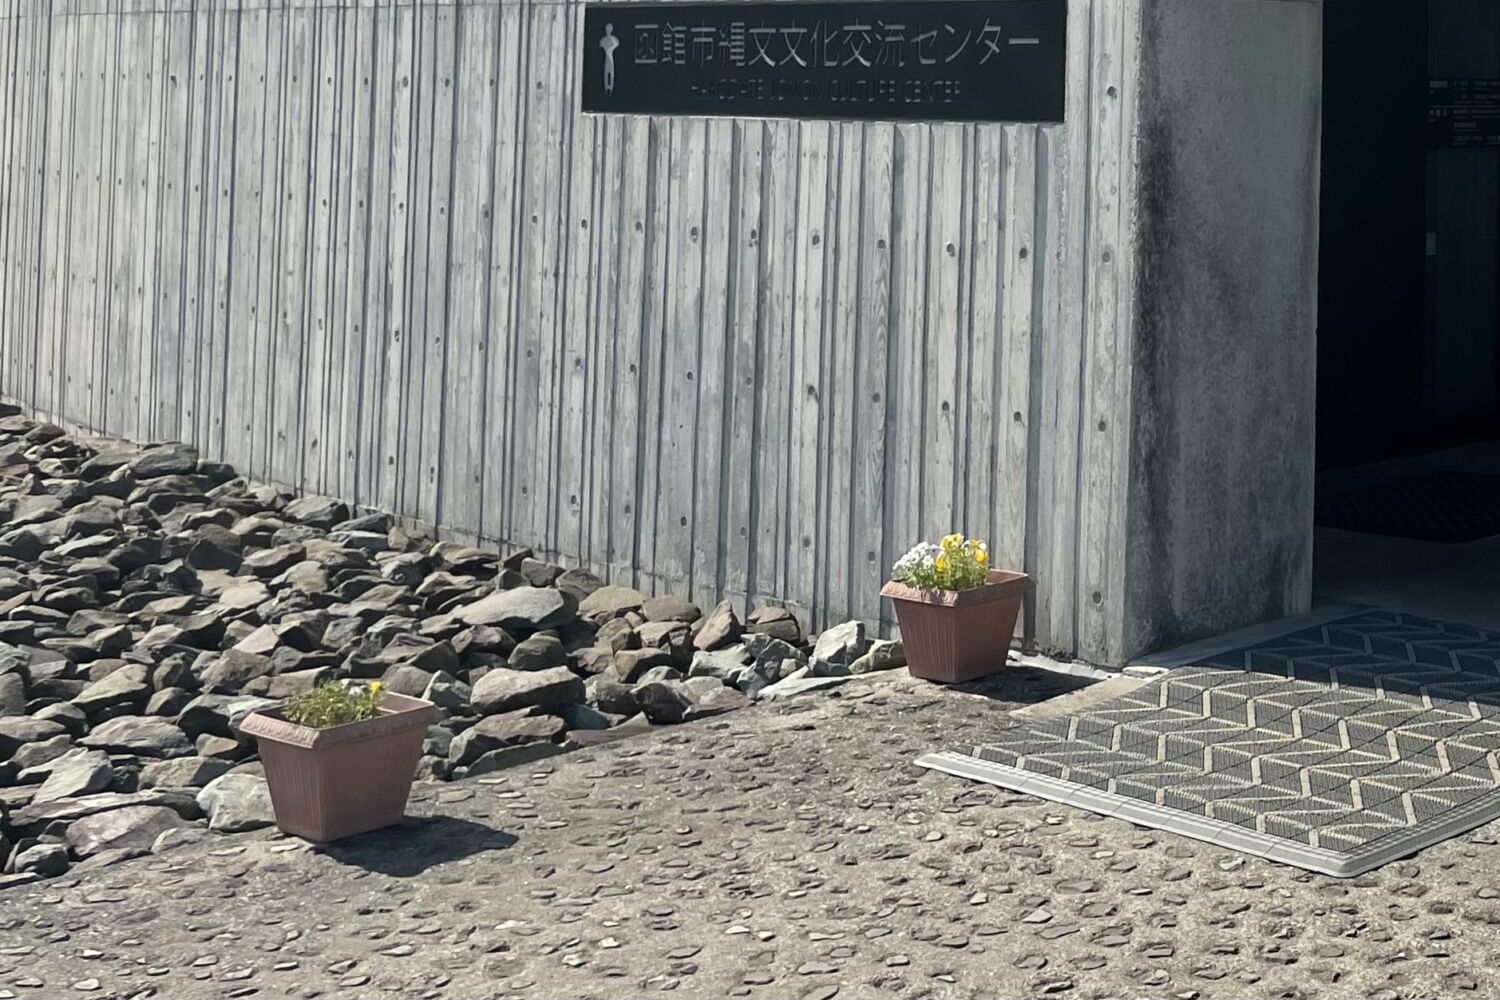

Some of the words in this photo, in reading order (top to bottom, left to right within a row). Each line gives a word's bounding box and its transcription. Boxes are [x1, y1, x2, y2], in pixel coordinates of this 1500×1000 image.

[634, 18, 1040, 68] 函館市縄文文化交流センター
[768, 77, 822, 102] JOMON
[831, 78, 897, 103] CULTURE
[903, 79, 963, 104] CENTER
